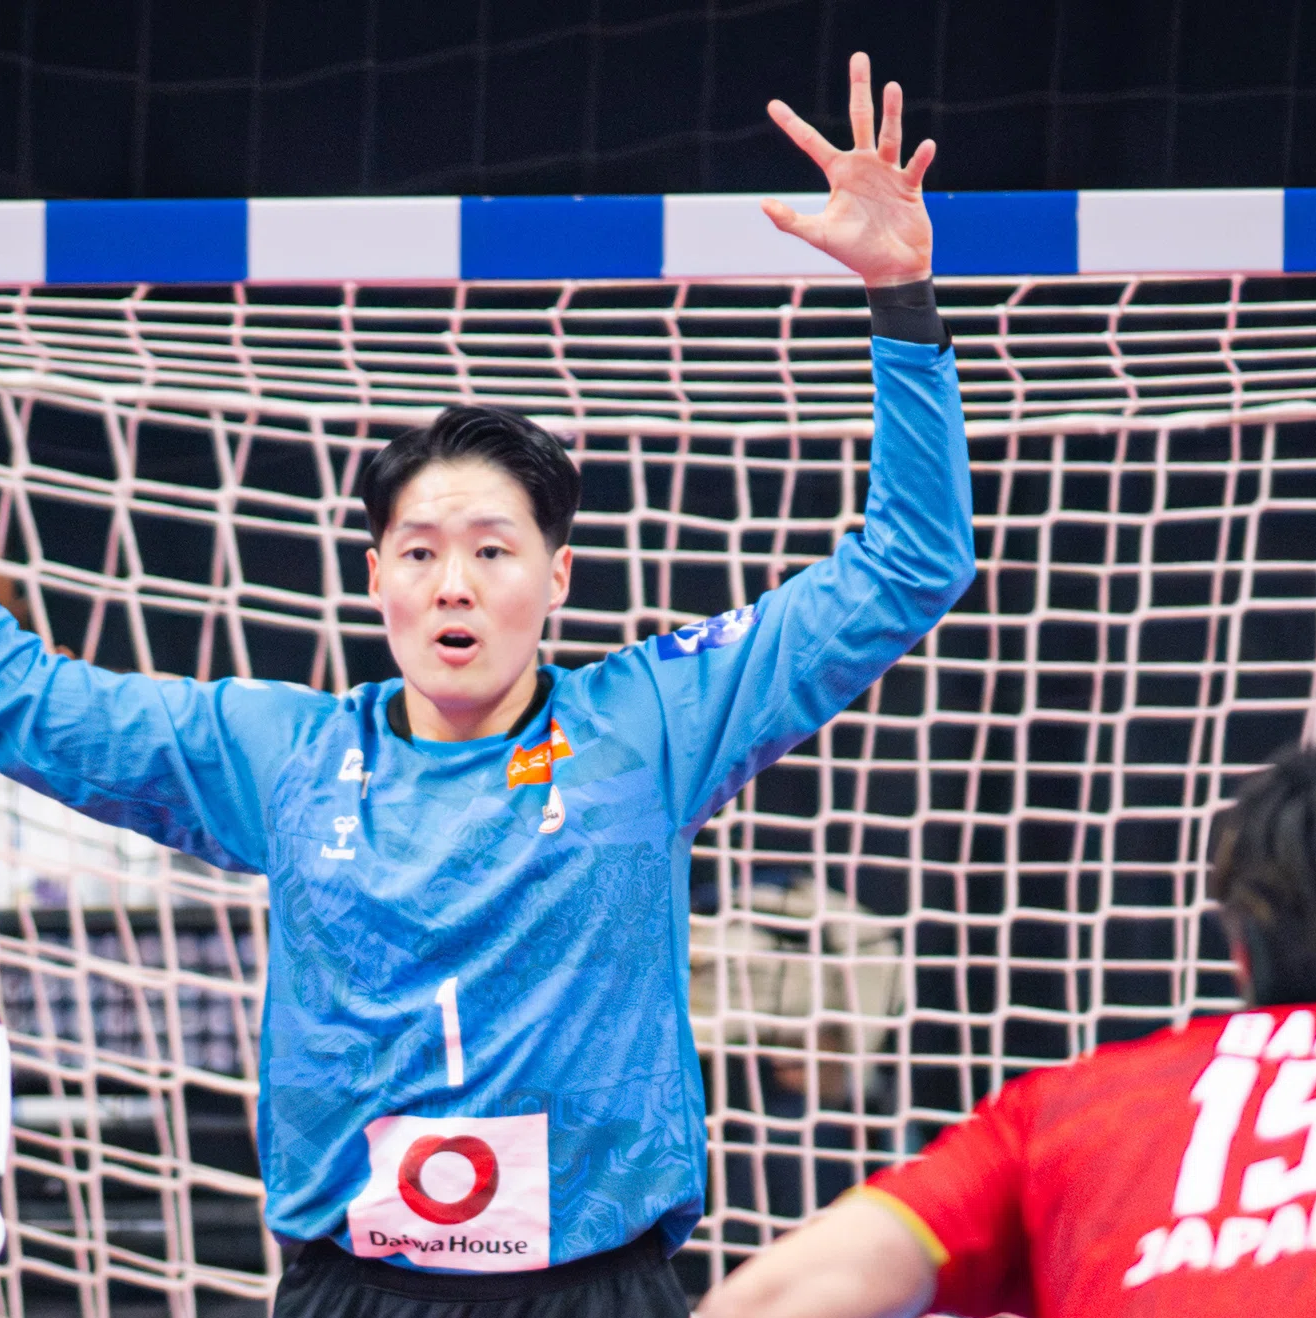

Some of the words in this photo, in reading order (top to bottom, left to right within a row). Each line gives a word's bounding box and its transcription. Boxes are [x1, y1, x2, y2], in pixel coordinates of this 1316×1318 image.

[435, 976, 465, 1086] 1
[369, 1230, 444, 1253] Daiwa
[449, 1235, 528, 1254] House
